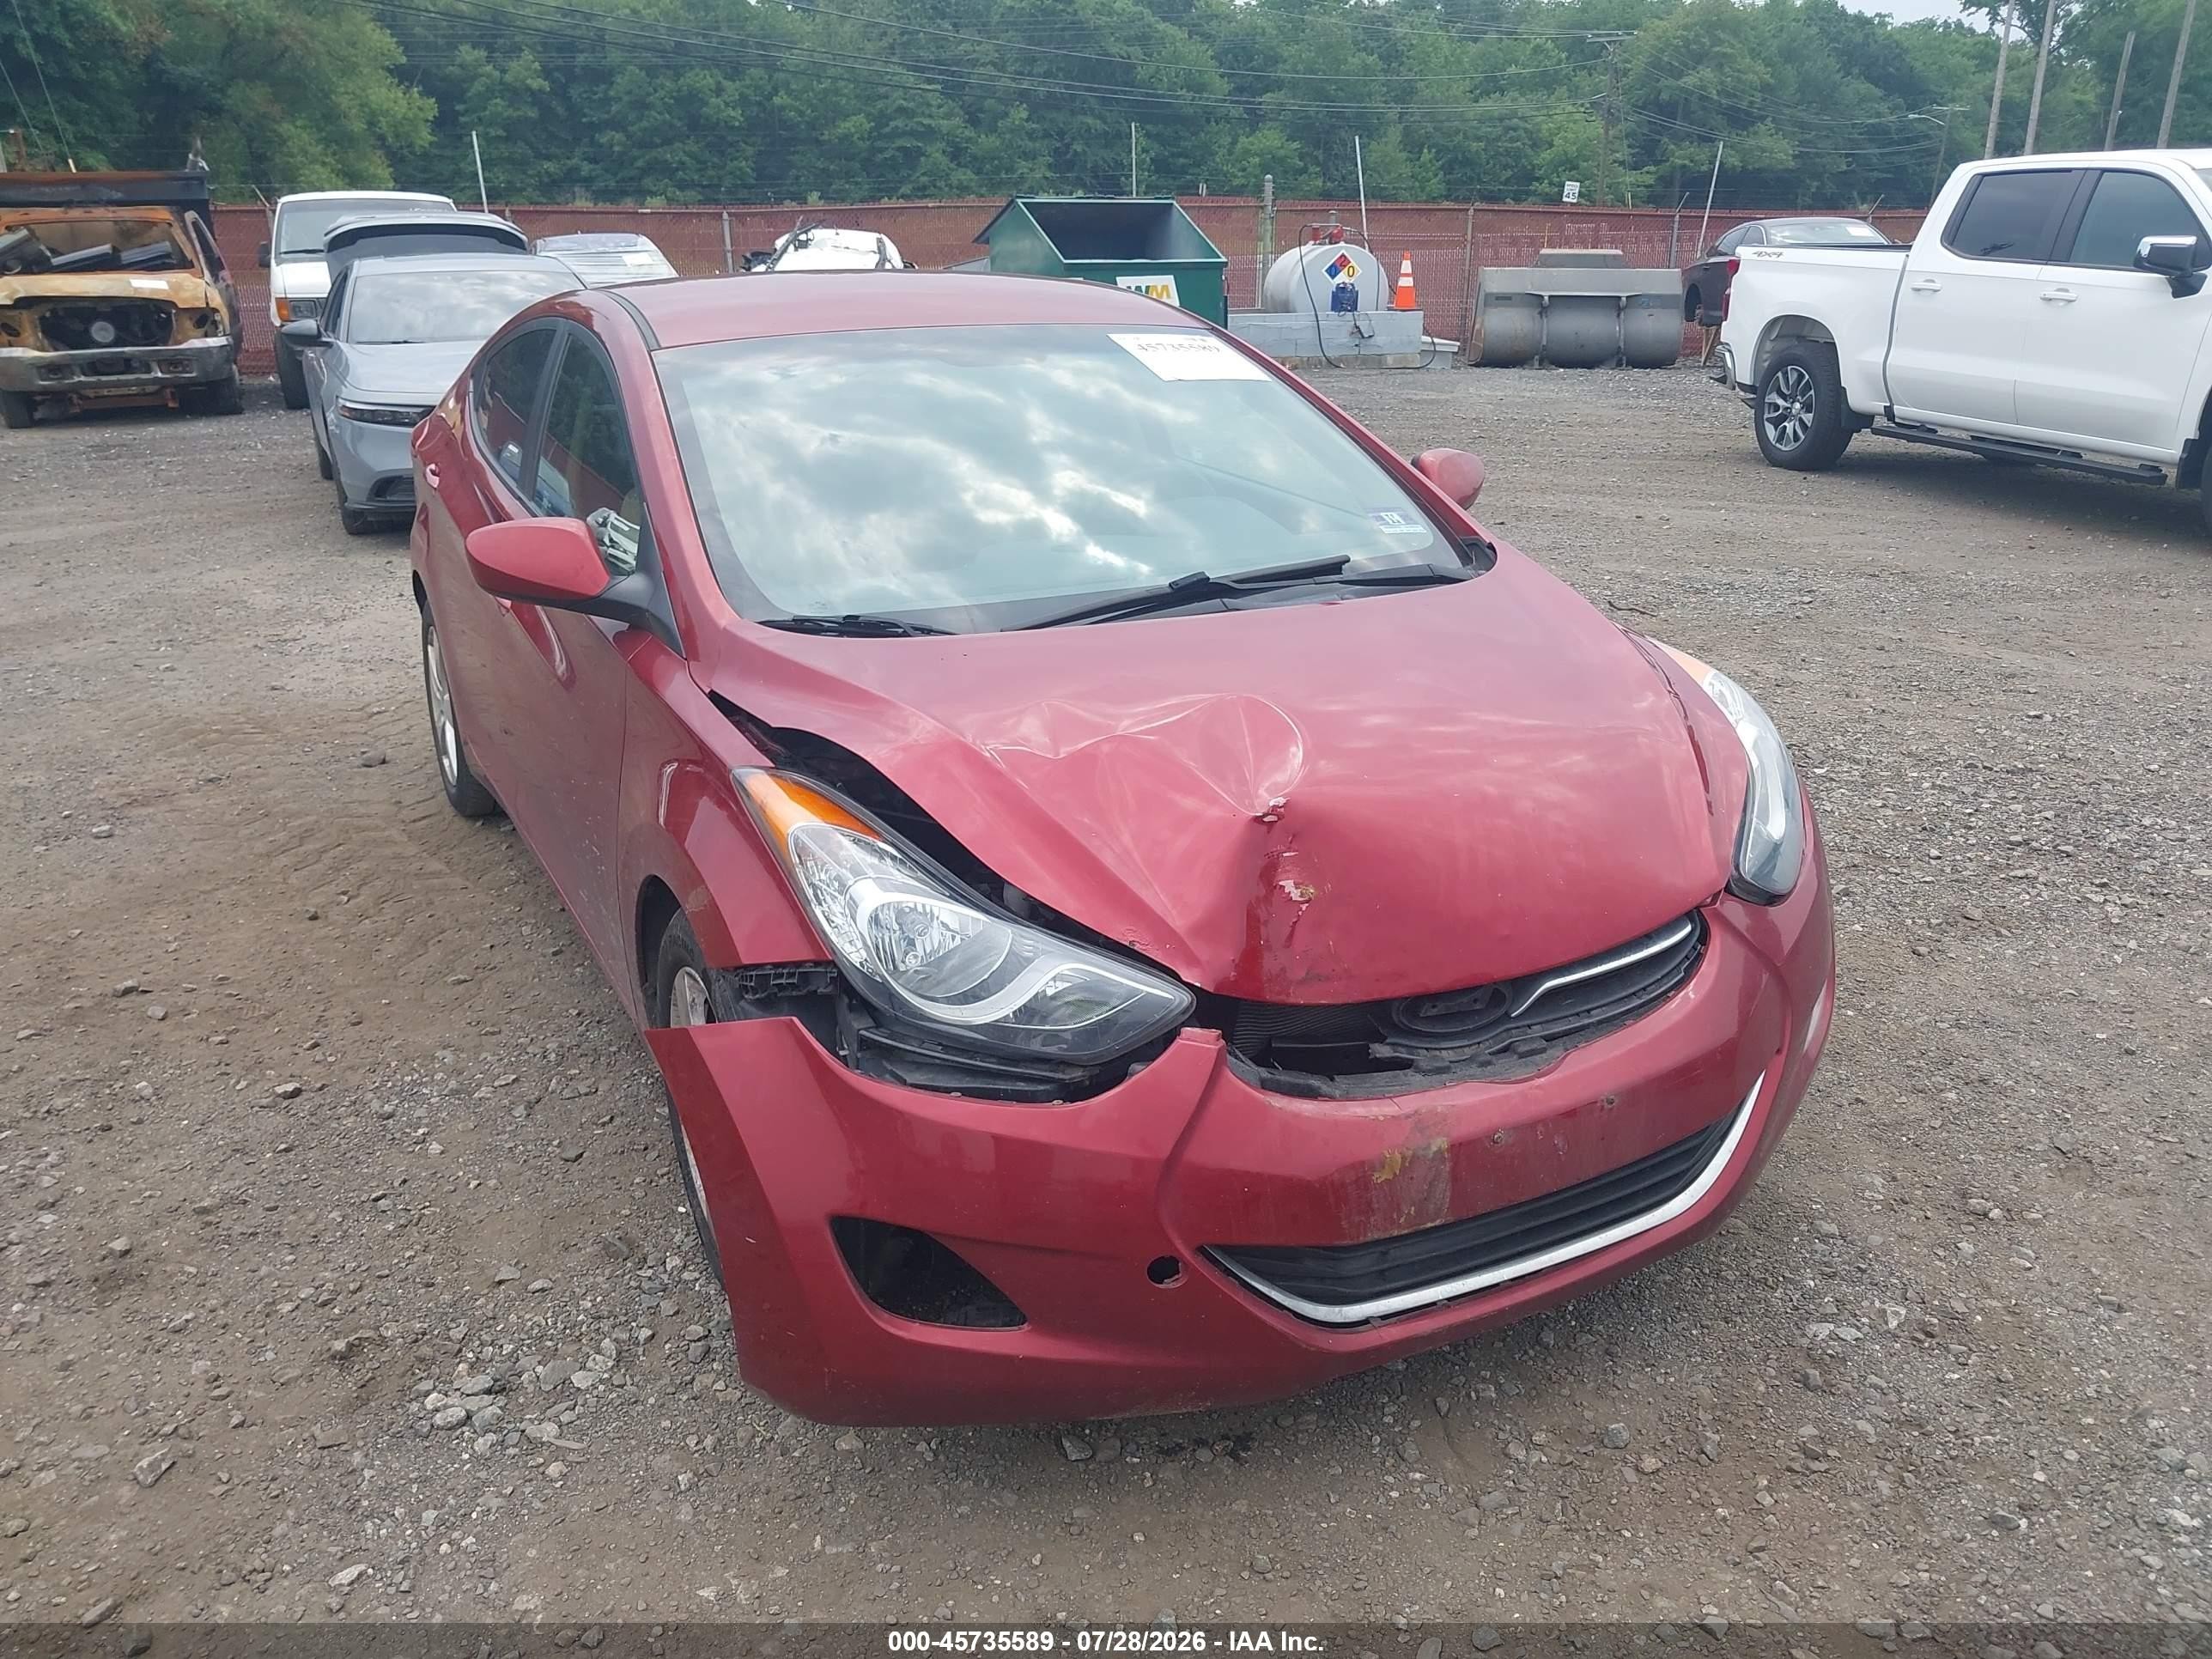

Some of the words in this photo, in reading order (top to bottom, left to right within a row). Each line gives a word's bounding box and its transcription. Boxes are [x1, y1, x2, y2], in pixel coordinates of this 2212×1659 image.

[1565, 191, 1577, 200] 45
[1340, 255, 1348, 267] 2
[1347, 265, 1355, 277] 0
